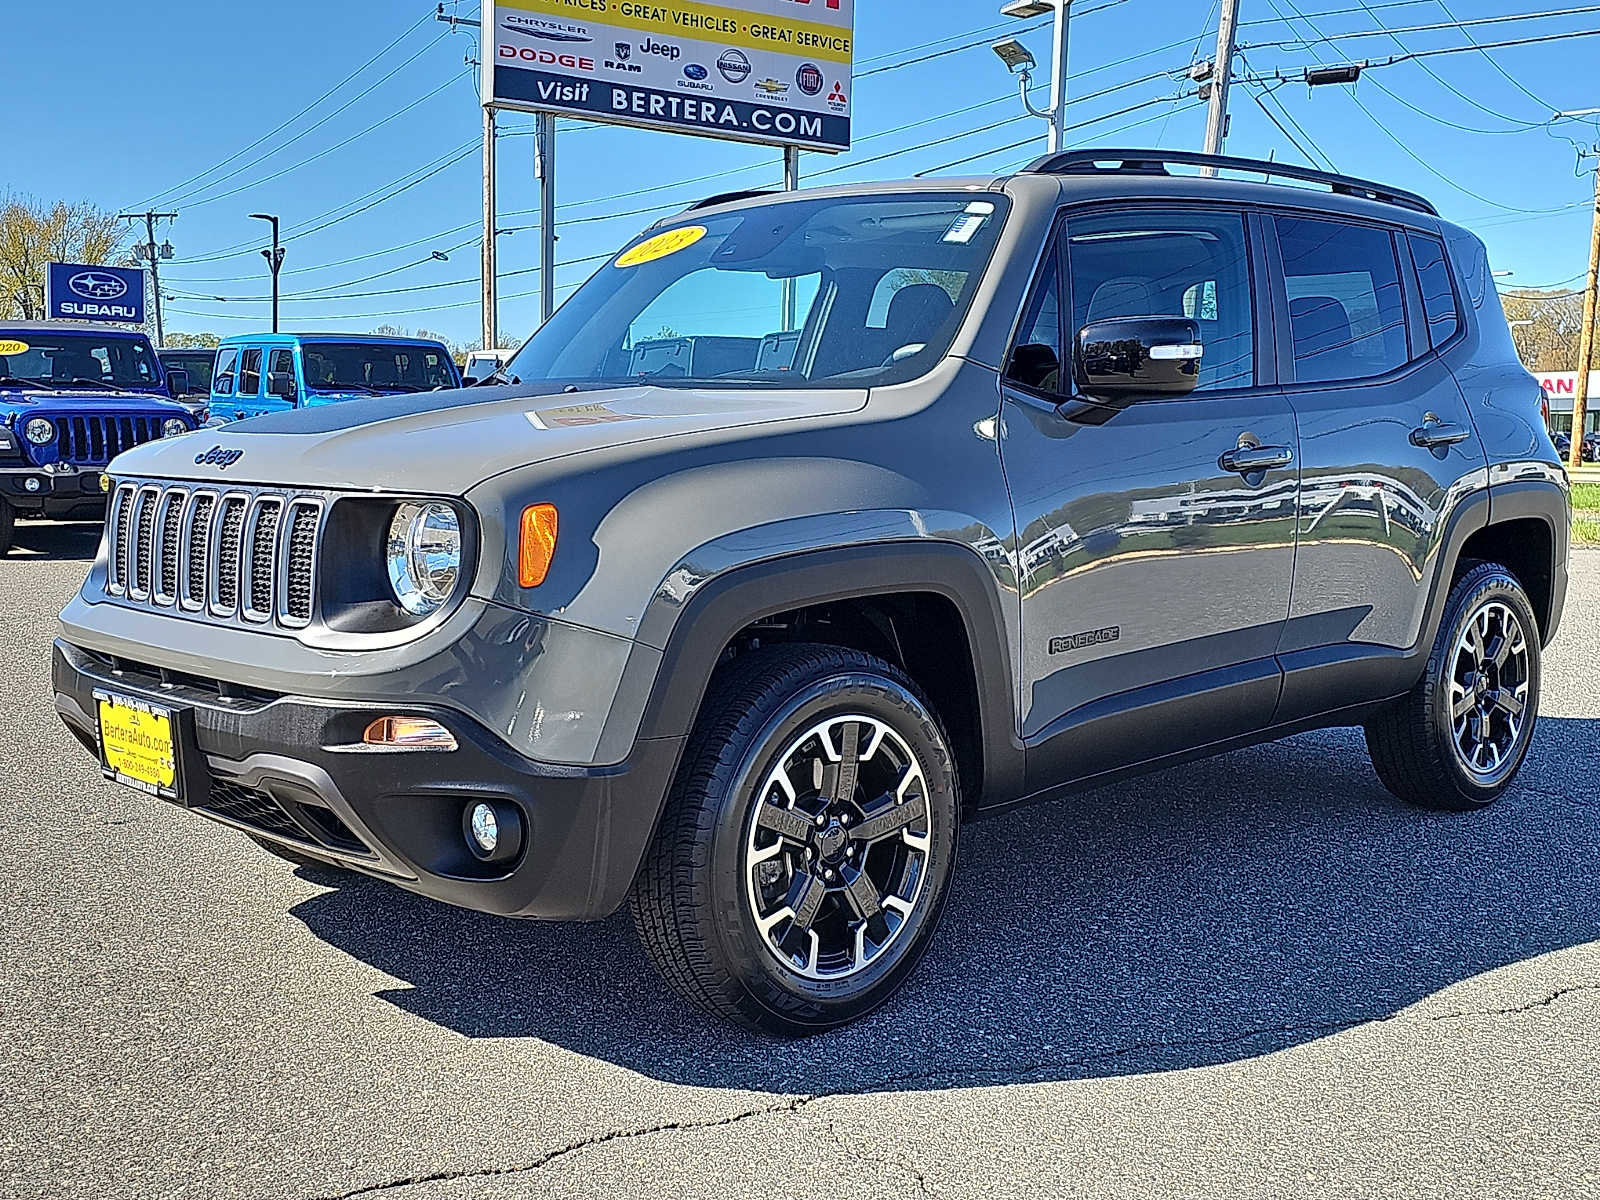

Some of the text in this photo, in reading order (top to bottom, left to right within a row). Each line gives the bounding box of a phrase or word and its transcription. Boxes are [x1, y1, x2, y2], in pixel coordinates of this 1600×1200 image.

[506, 16, 587, 34] CHRYSLER
[620, 2, 667, 22] GREAT
[672, 10, 737, 33] VEHICLES
[751, 24, 792, 43] GREAT
[797, 31, 850, 52] SERVICE
[499, 45, 594, 71] DODGE
[640, 38, 680, 60] Jeep
[604, 60, 642, 73] RAM
[719, 61, 749, 71] NISSAN
[677, 80, 714, 91] SUBARU
[803, 72, 818, 88] FIAT
[537, 81, 822, 137] Visit BERTERA.COM
[622, 230, 696, 263] 2023
[60, 302, 136, 318] SUBARU
[194, 445, 244, 470] Jeep
[1049, 626, 1120, 655] RENEGADE
